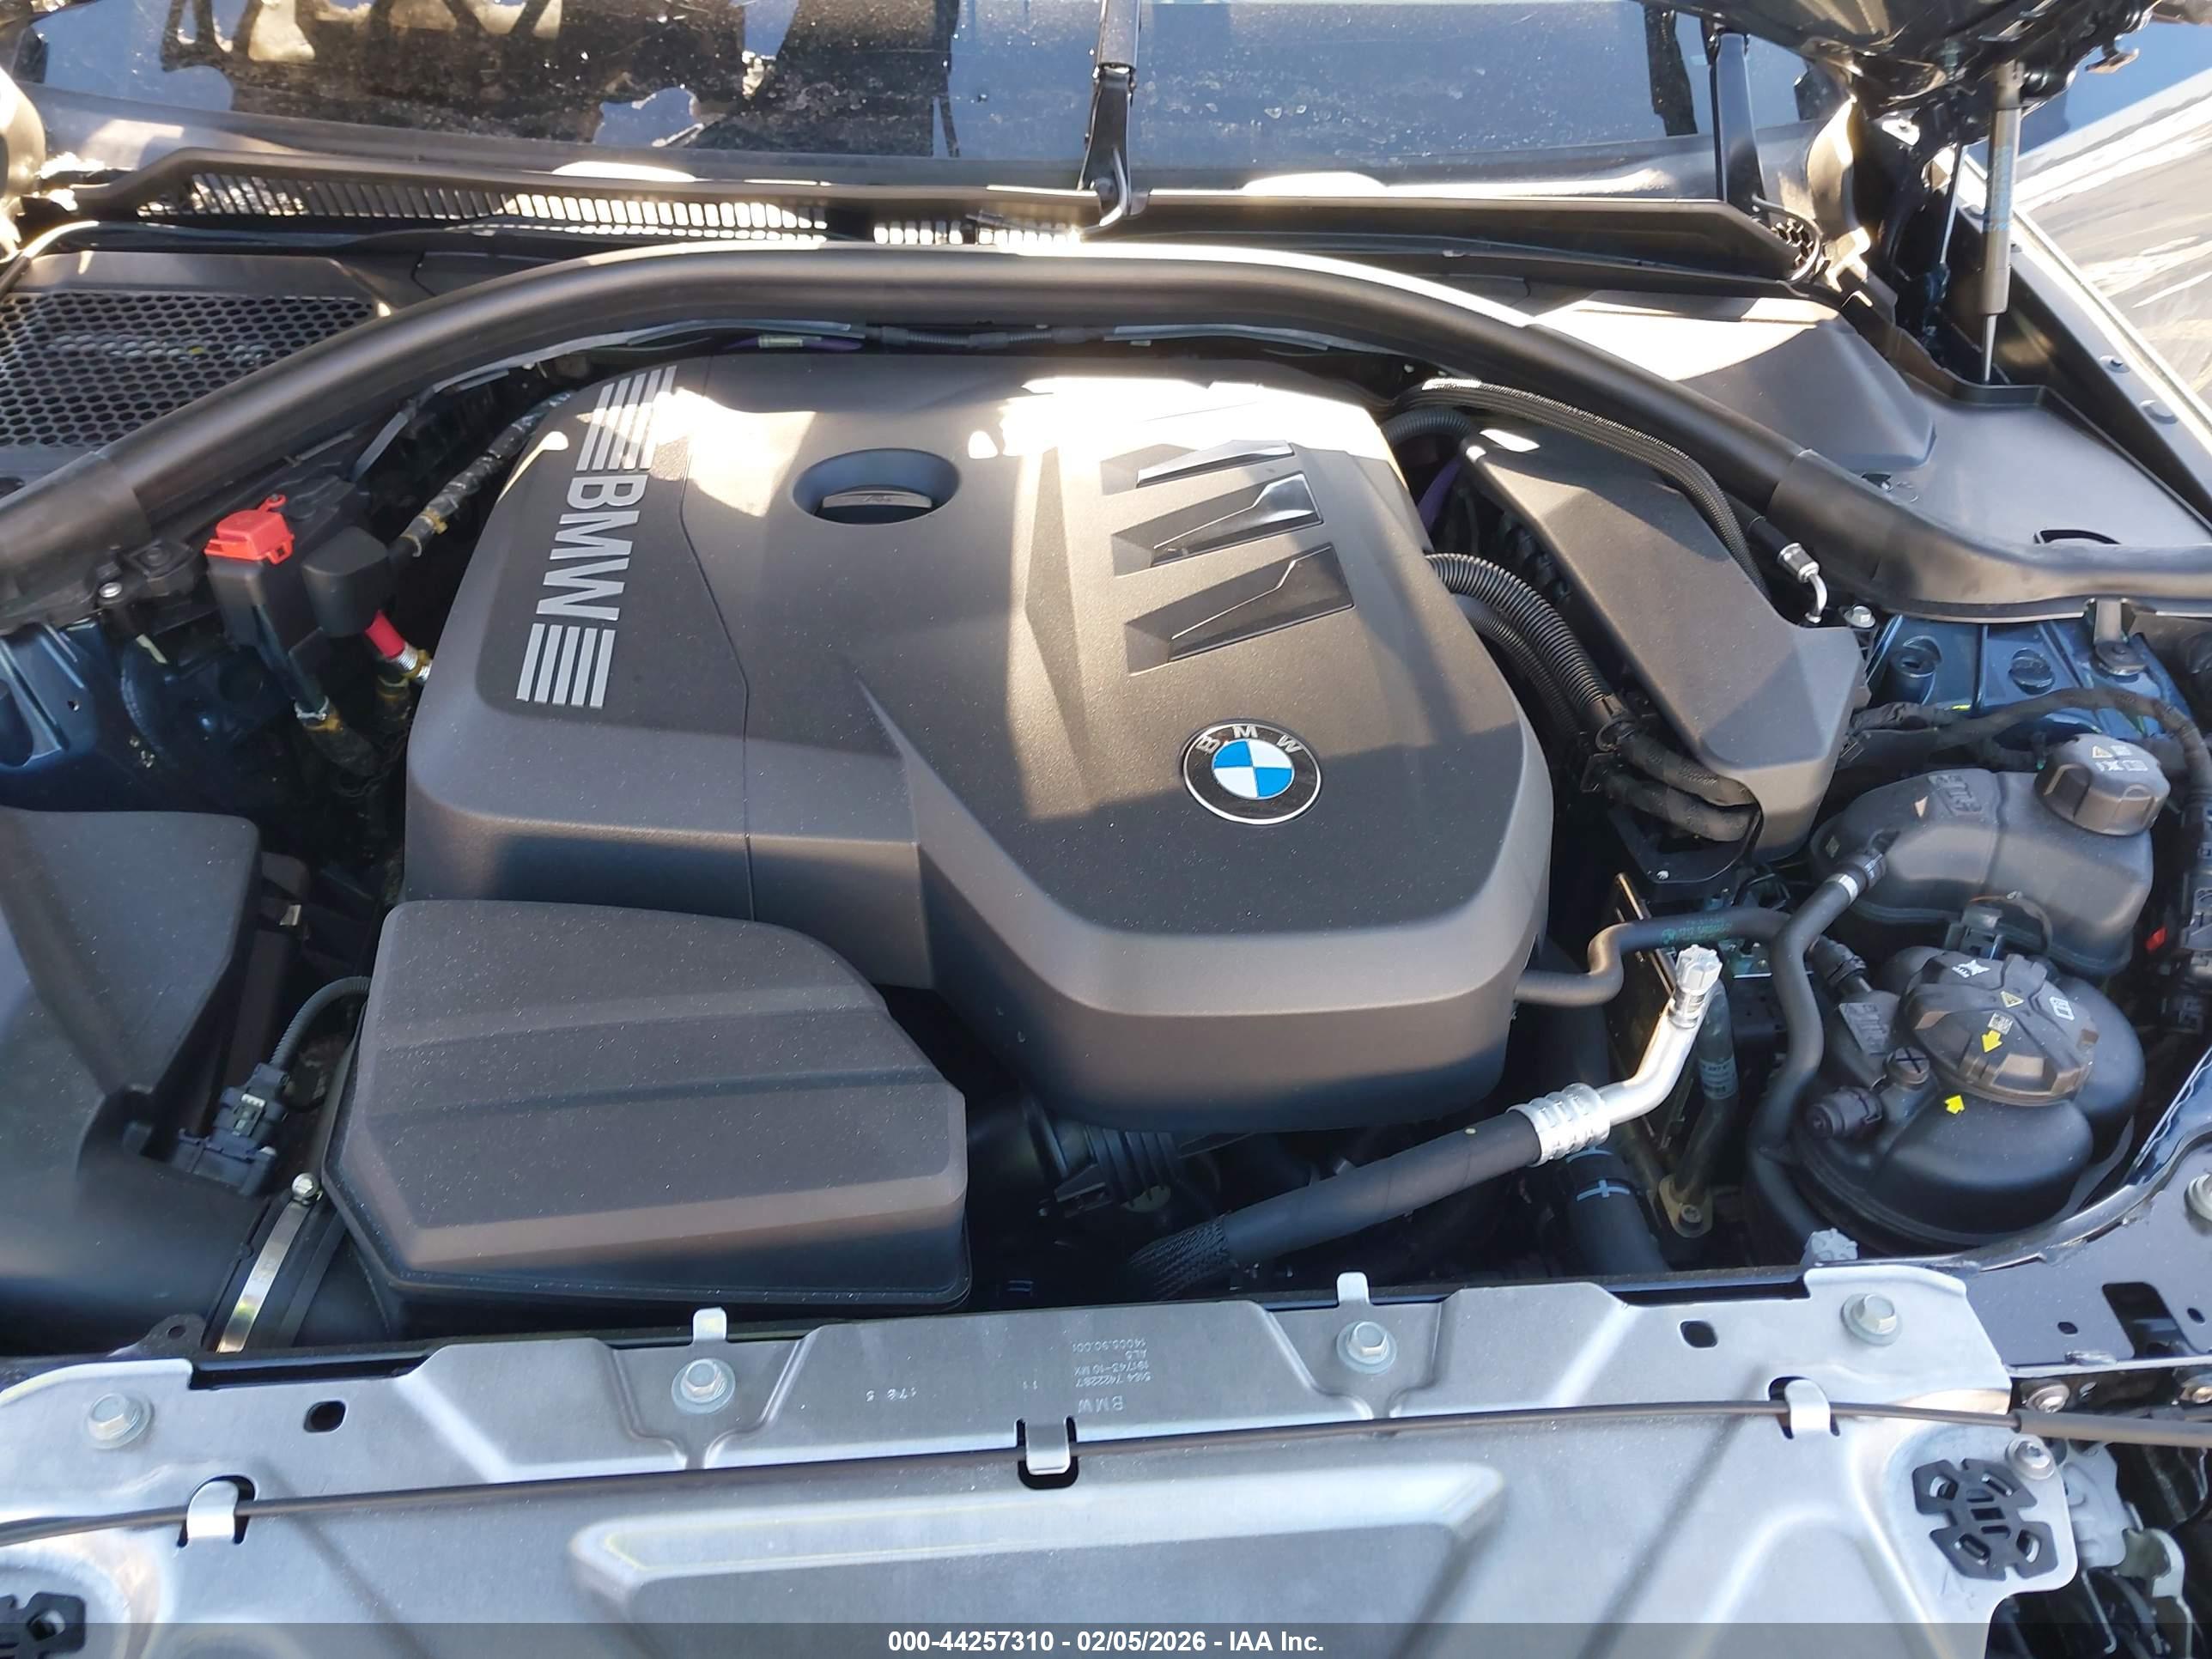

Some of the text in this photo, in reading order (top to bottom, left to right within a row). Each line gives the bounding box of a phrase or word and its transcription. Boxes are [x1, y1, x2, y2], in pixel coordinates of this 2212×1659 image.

[536, 475, 647, 621] BMW
[1195, 726, 1304, 755] BMW
[1078, 1395, 1123, 1413] BMW
